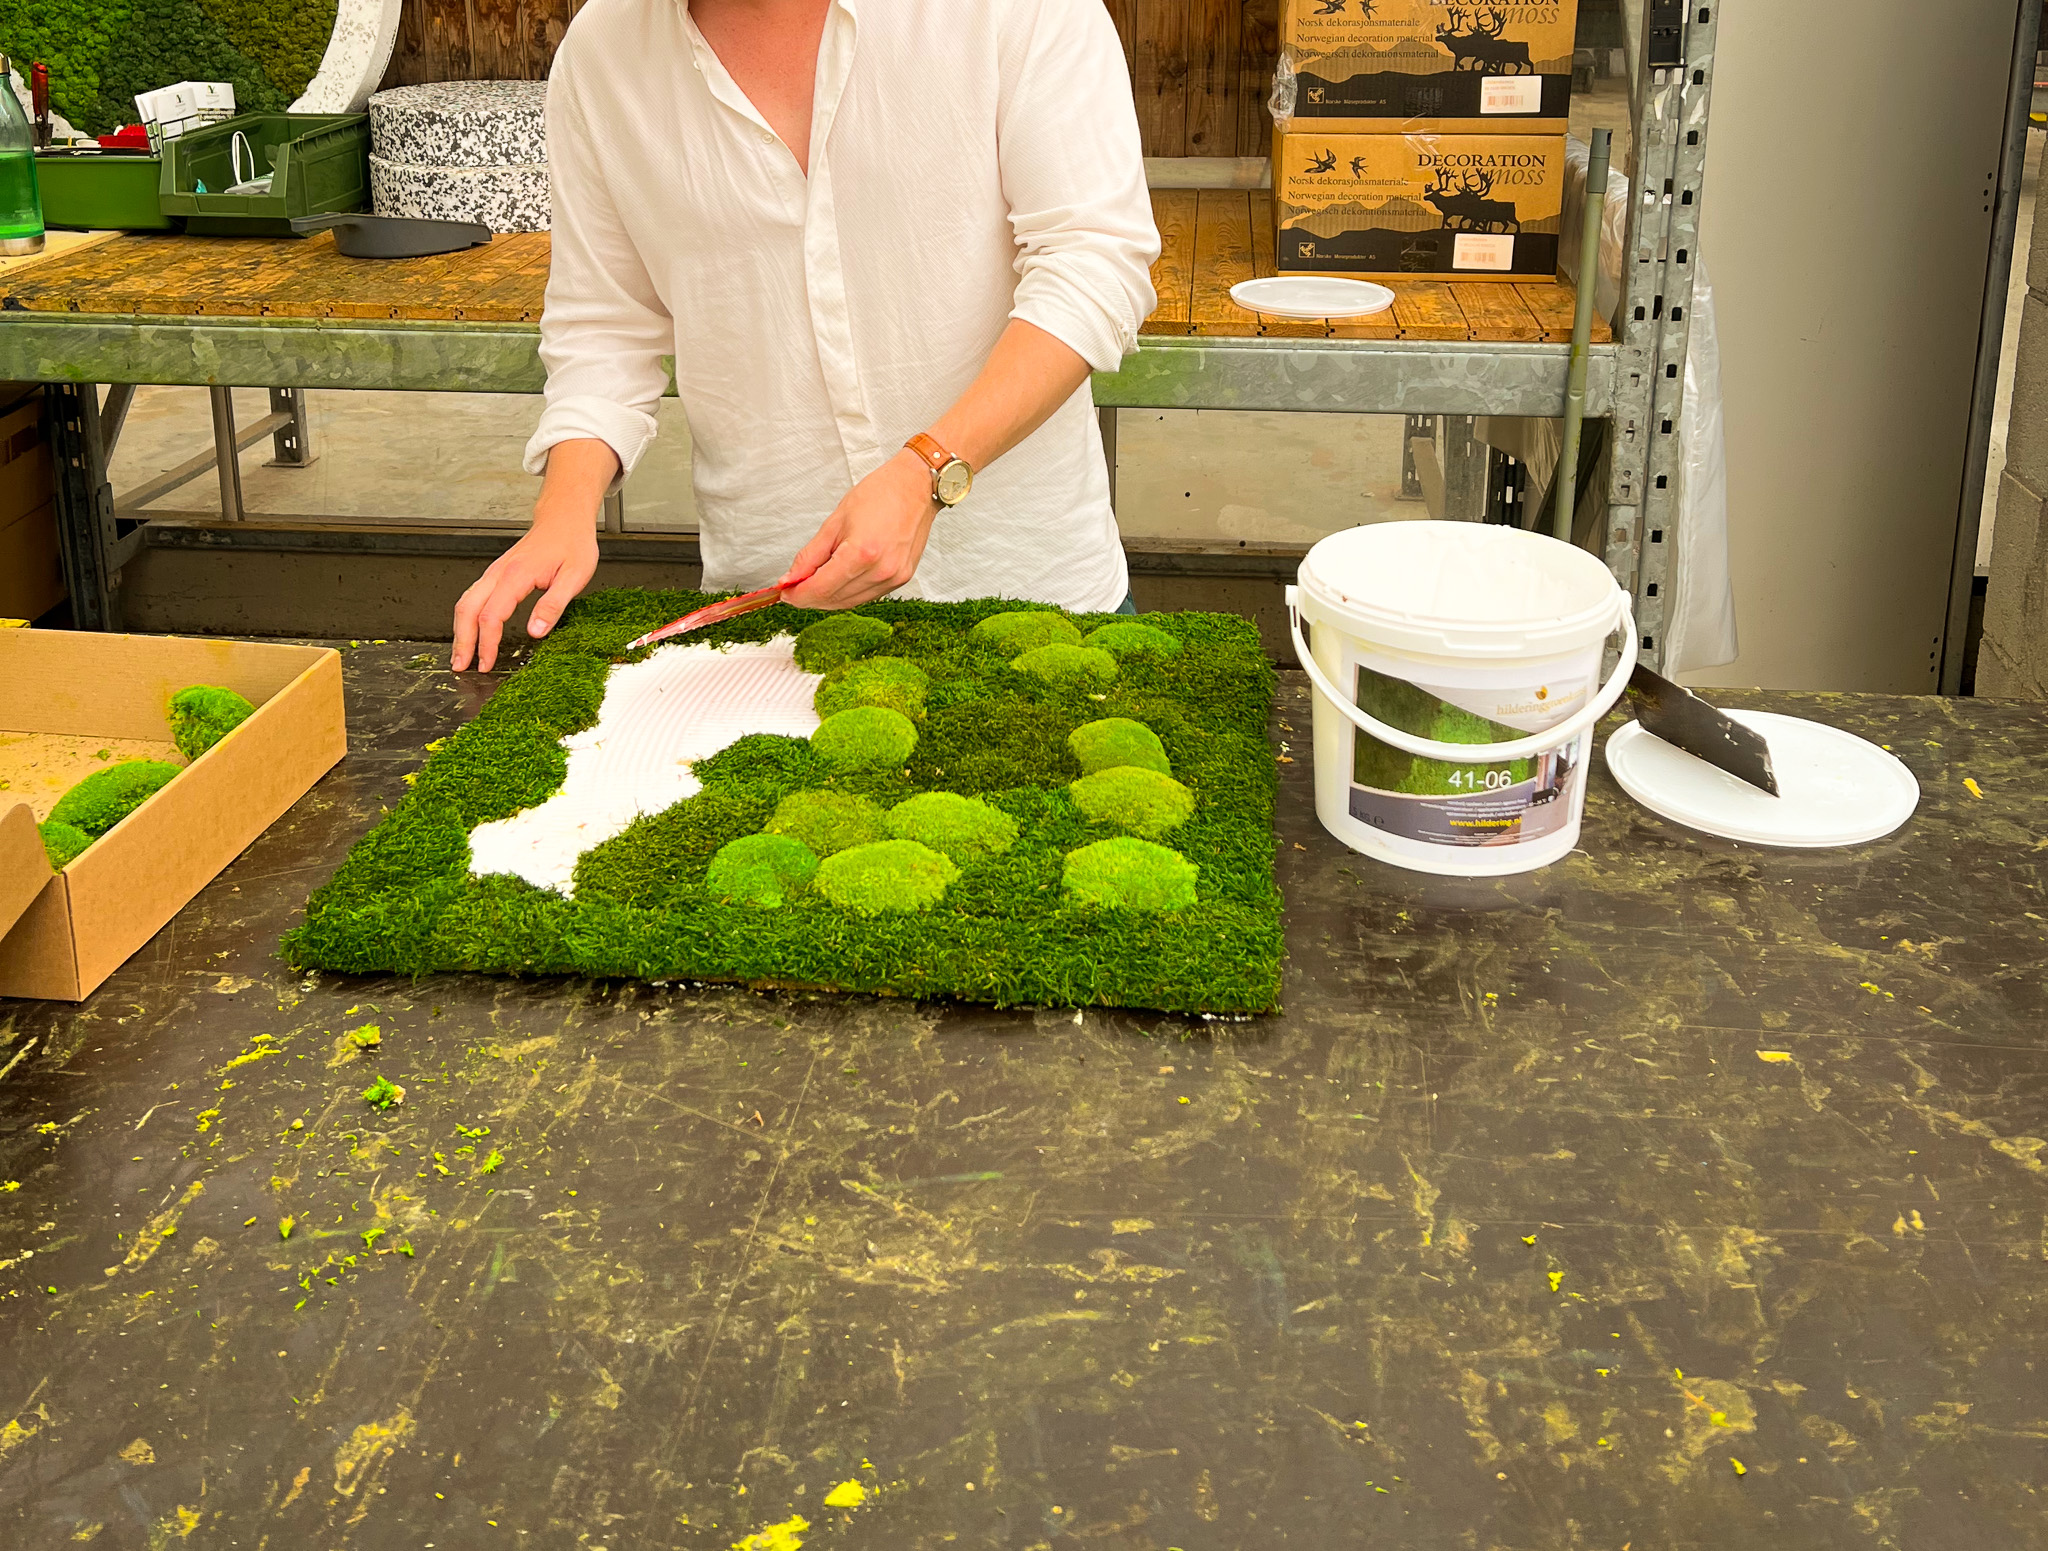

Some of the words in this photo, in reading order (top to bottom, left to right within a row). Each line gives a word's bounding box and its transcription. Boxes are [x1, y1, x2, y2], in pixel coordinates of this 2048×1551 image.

[1502, 7, 1560, 24] moss
[1297, 18, 1324, 27] Norsk
[1326, 18, 1420, 29] dekorasjonsmateriale
[1296, 34, 1345, 45] Norwegian
[1348, 34, 1394, 43] decoration
[1397, 34, 1433, 43] material
[1296, 50, 1350, 60] Norwegisch
[1351, 50, 1439, 59] dekorationsmaterial
[1418, 153, 1547, 167] DECORATION
[1288, 176, 1314, 185] Norsk
[1317, 176, 1409, 188] dekorasjonsmateriale
[1489, 168, 1546, 185] moss
[1288, 191, 1335, 203] Norwegian
[1338, 192, 1383, 201] decoration
[1386, 192, 1421, 202] material
[1288, 206, 1339, 217] Norwegisch
[1341, 207, 1427, 217] dekorationsmaterial
[1448, 770, 1512, 789] 41-06
[1449, 814, 1522, 827] www.hildering.nl
